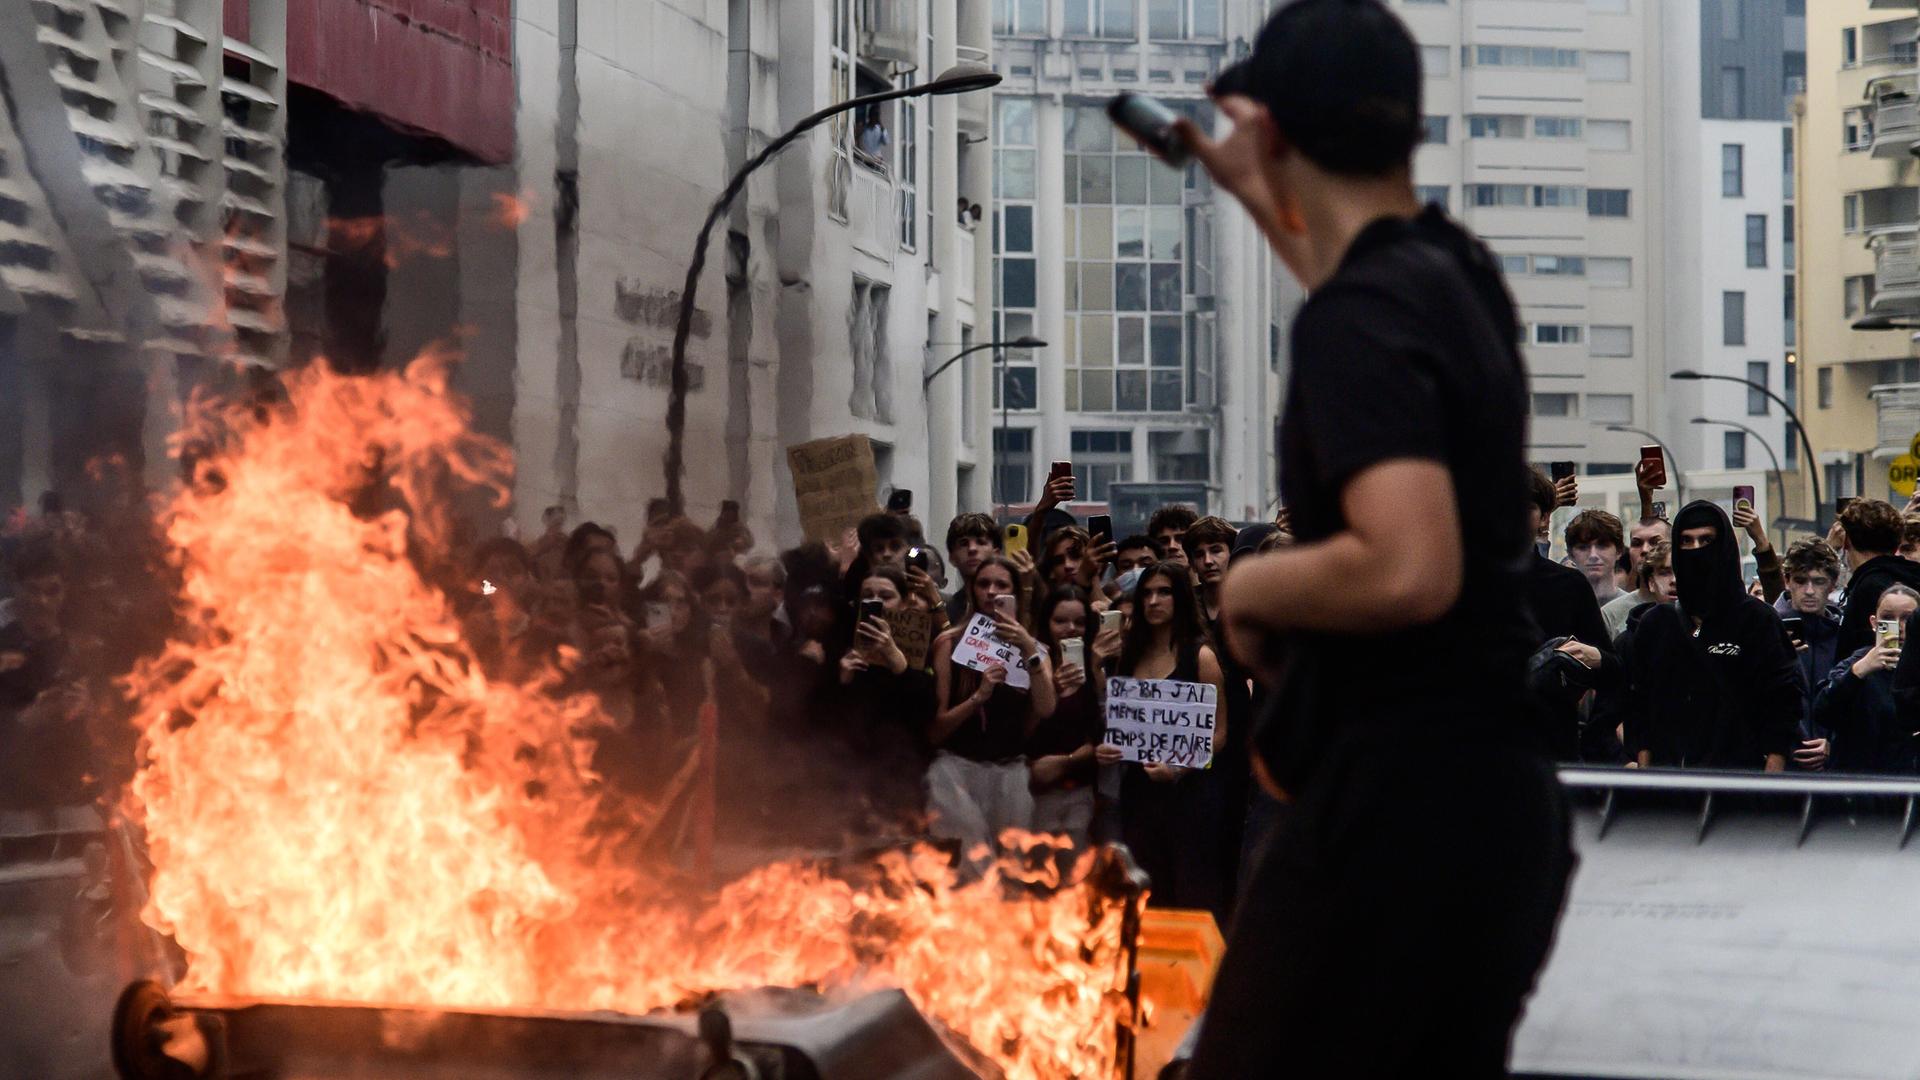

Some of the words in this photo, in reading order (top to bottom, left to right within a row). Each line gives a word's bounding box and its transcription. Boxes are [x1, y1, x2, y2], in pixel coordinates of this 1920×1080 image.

[996, 648, 1014, 663] QUE
[1171, 683, 1206, 703] J'AI
[1152, 709, 1191, 727] PLUS
[1196, 713, 1213, 729] LE
[1106, 728, 1146, 748] TEMPS
[1150, 733, 1168, 750] DE
[1172, 732, 1211, 754] FAIRE
[1138, 750, 1162, 763] DES
